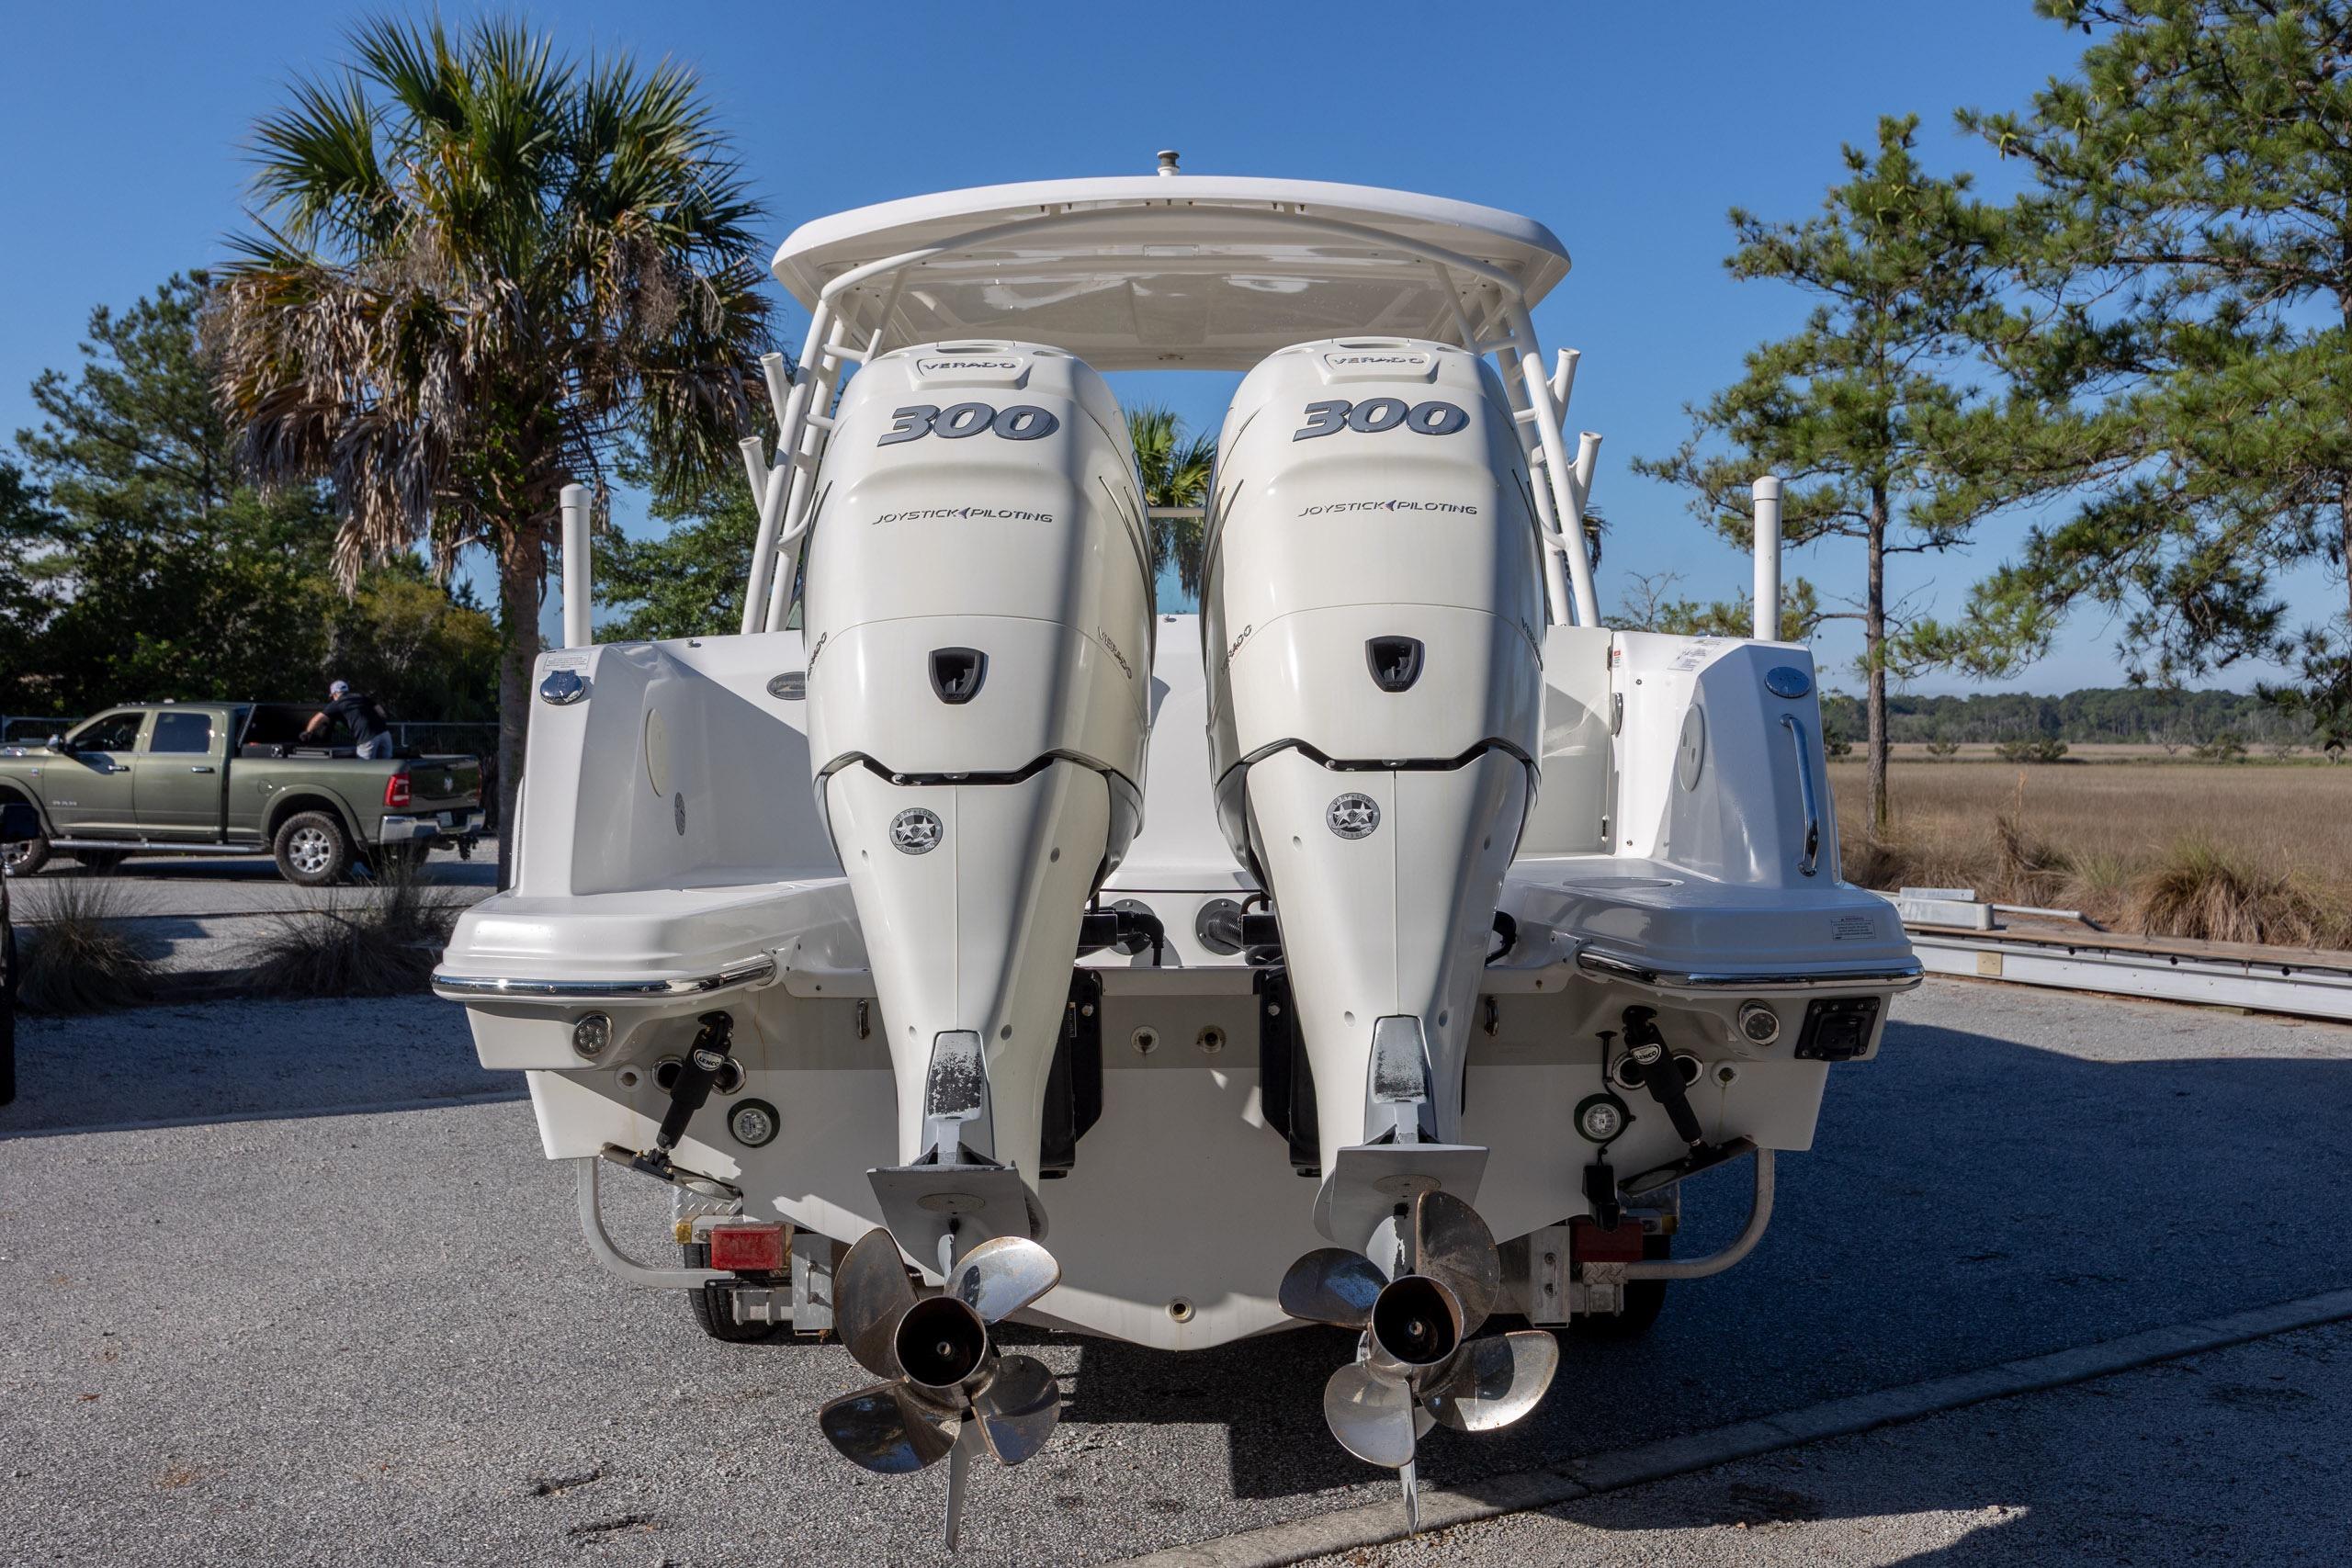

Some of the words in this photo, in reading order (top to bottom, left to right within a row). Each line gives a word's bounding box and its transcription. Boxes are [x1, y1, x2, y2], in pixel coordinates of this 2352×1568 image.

[922, 361, 1016, 370] VERADO
[1333, 356, 1425, 365] VERADO
[877, 401, 1059, 447] 300
[1292, 397, 1470, 442] 300
[872, 508, 959, 525] JOYSTICK
[969, 508, 1053, 523] PILOTING
[1297, 501, 1385, 517] JOYSTICK
[1396, 501, 1478, 515] PILOTING
[1097, 626, 1133, 680] VERADO
[698, 1055, 720, 1066] LENCO
[1634, 1050, 1657, 1060] LENCO
